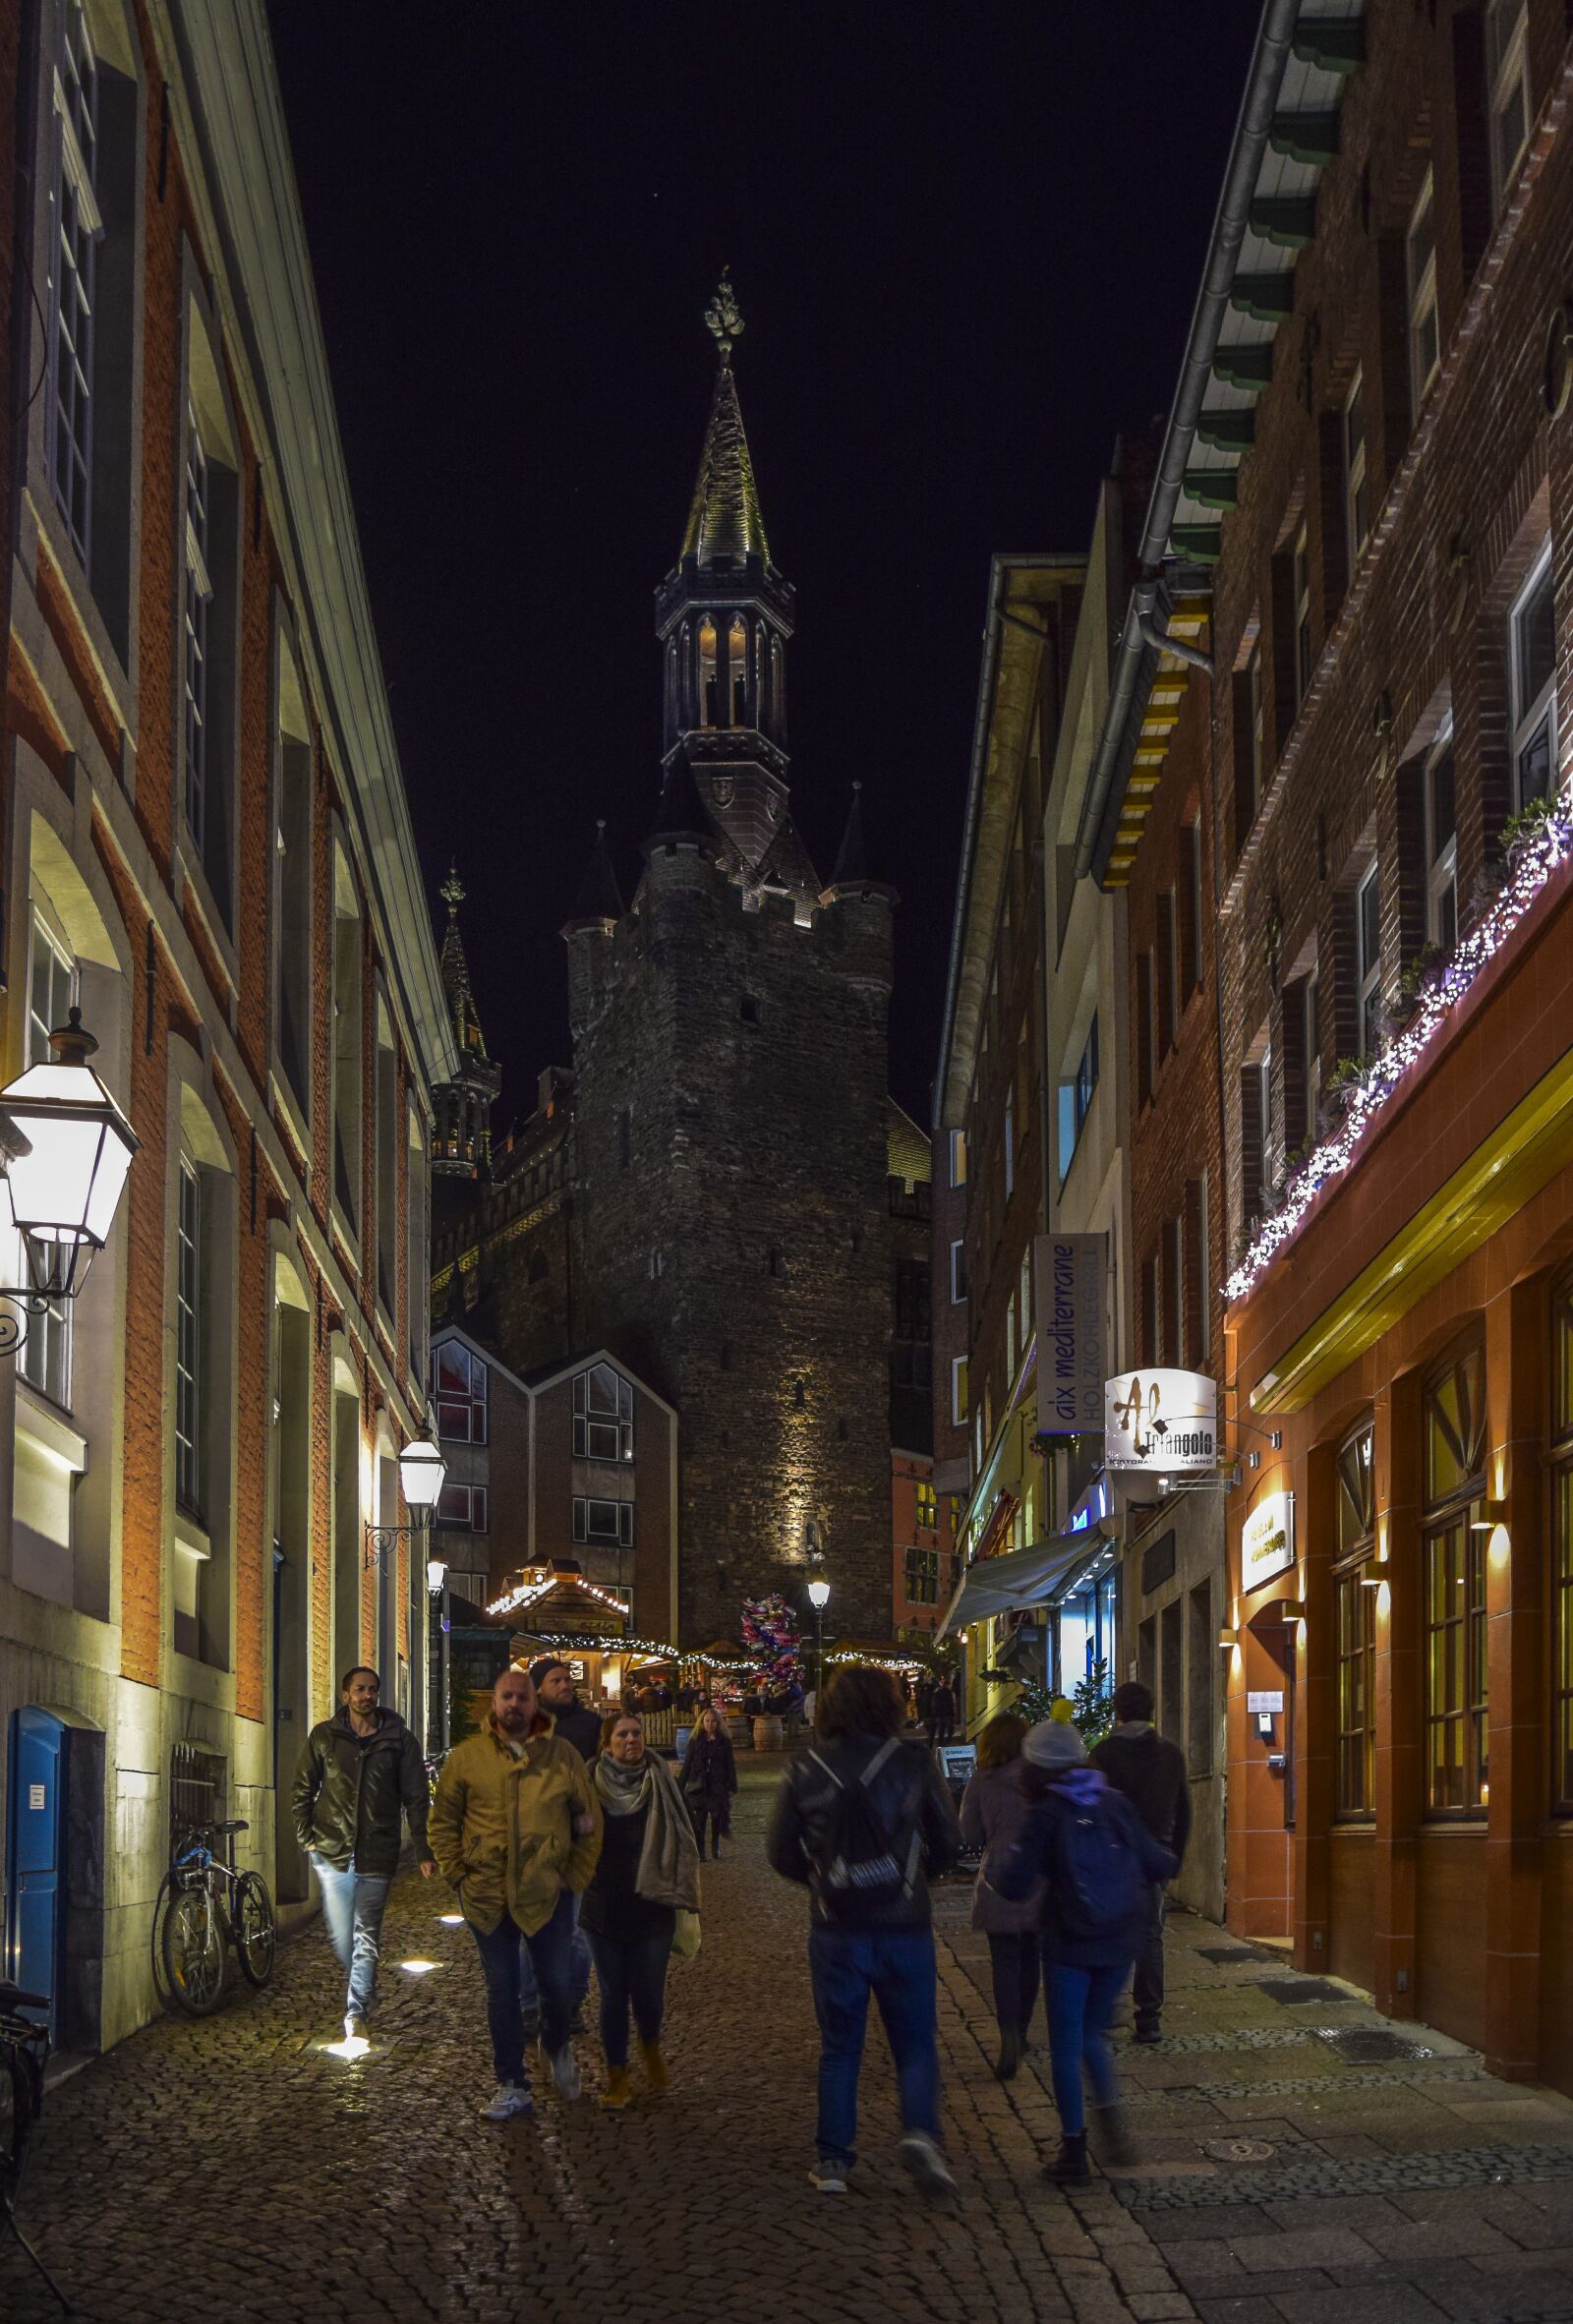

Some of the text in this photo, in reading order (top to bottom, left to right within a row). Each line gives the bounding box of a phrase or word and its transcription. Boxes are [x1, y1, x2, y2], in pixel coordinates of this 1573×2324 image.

[1047, 1245, 1077, 1421] aix mediterrane
[1145, 1430, 1212, 1457] Triangolo
